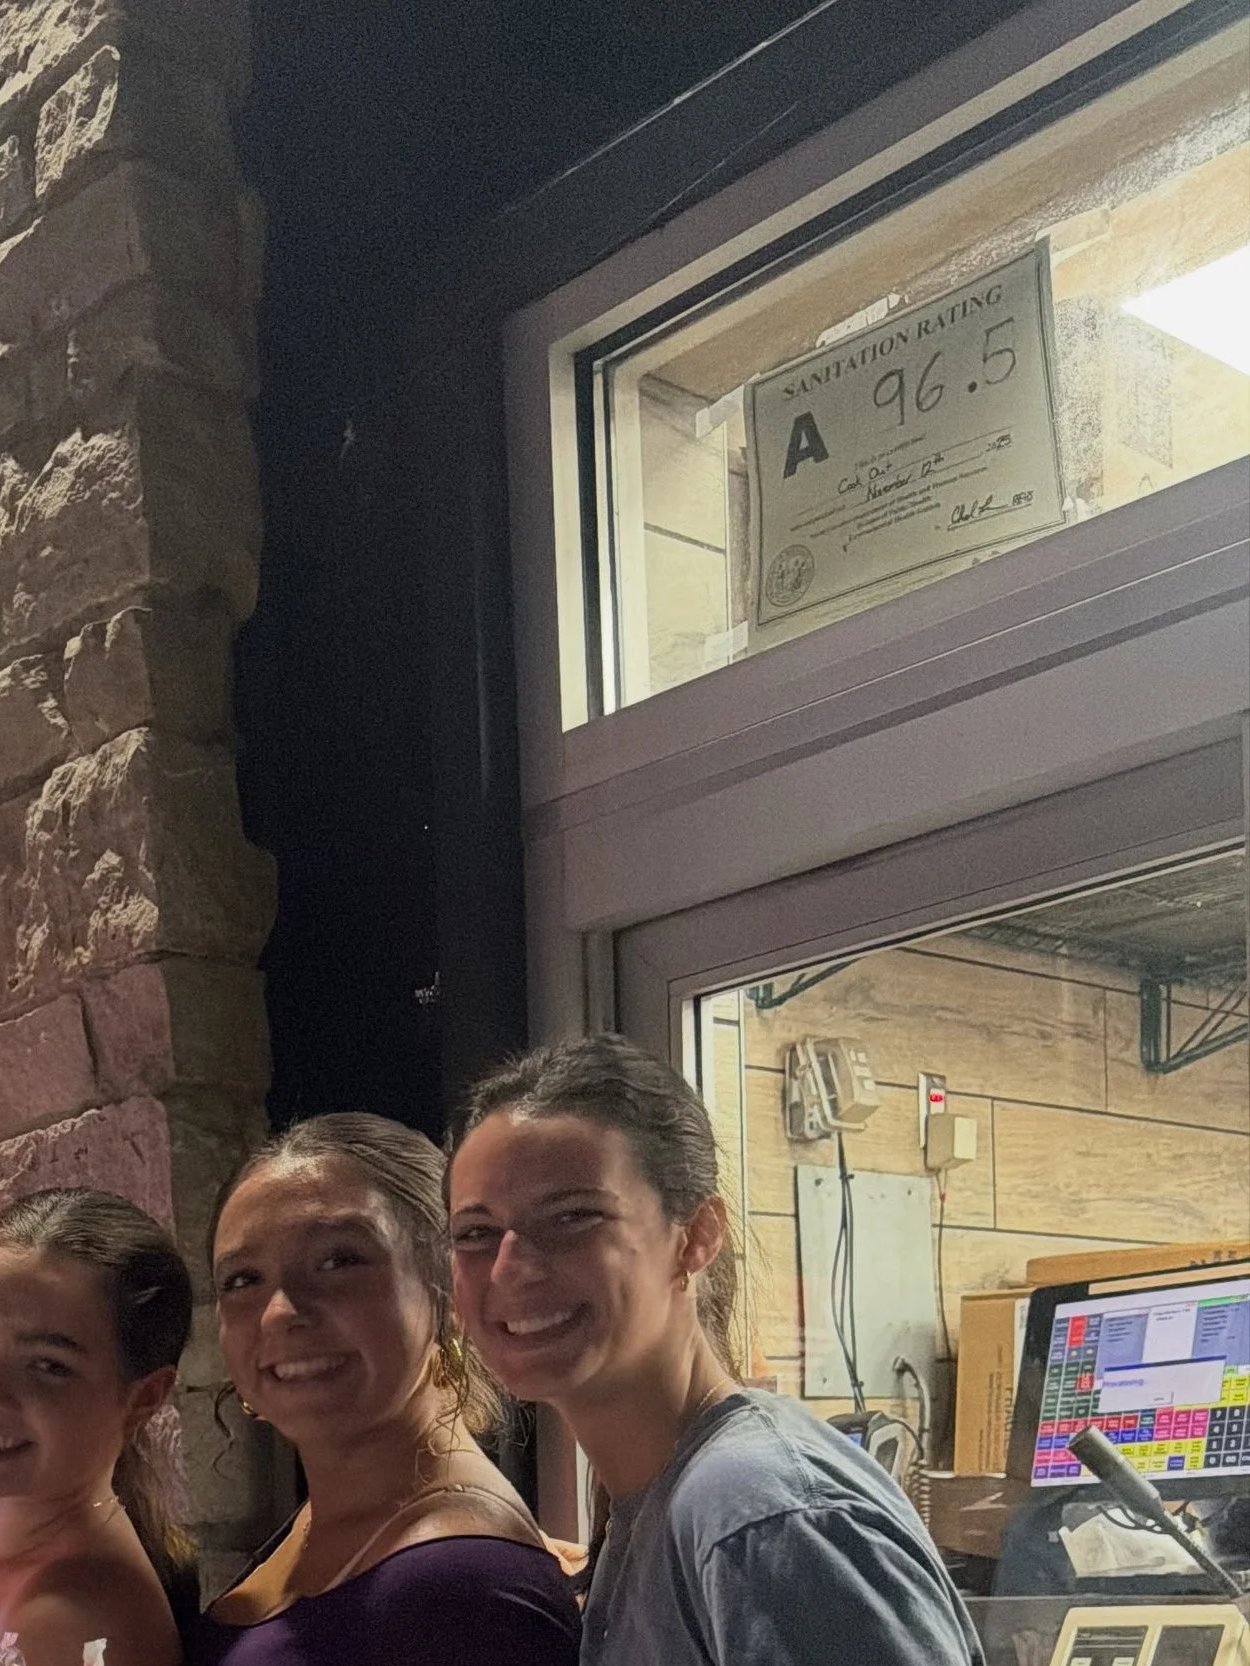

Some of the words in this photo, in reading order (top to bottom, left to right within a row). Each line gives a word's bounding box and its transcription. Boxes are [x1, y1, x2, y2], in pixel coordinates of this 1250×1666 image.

[782, 331, 909, 399] SANITATION
[917, 286, 1002, 336] RATING
[783, 411, 829, 479] A
